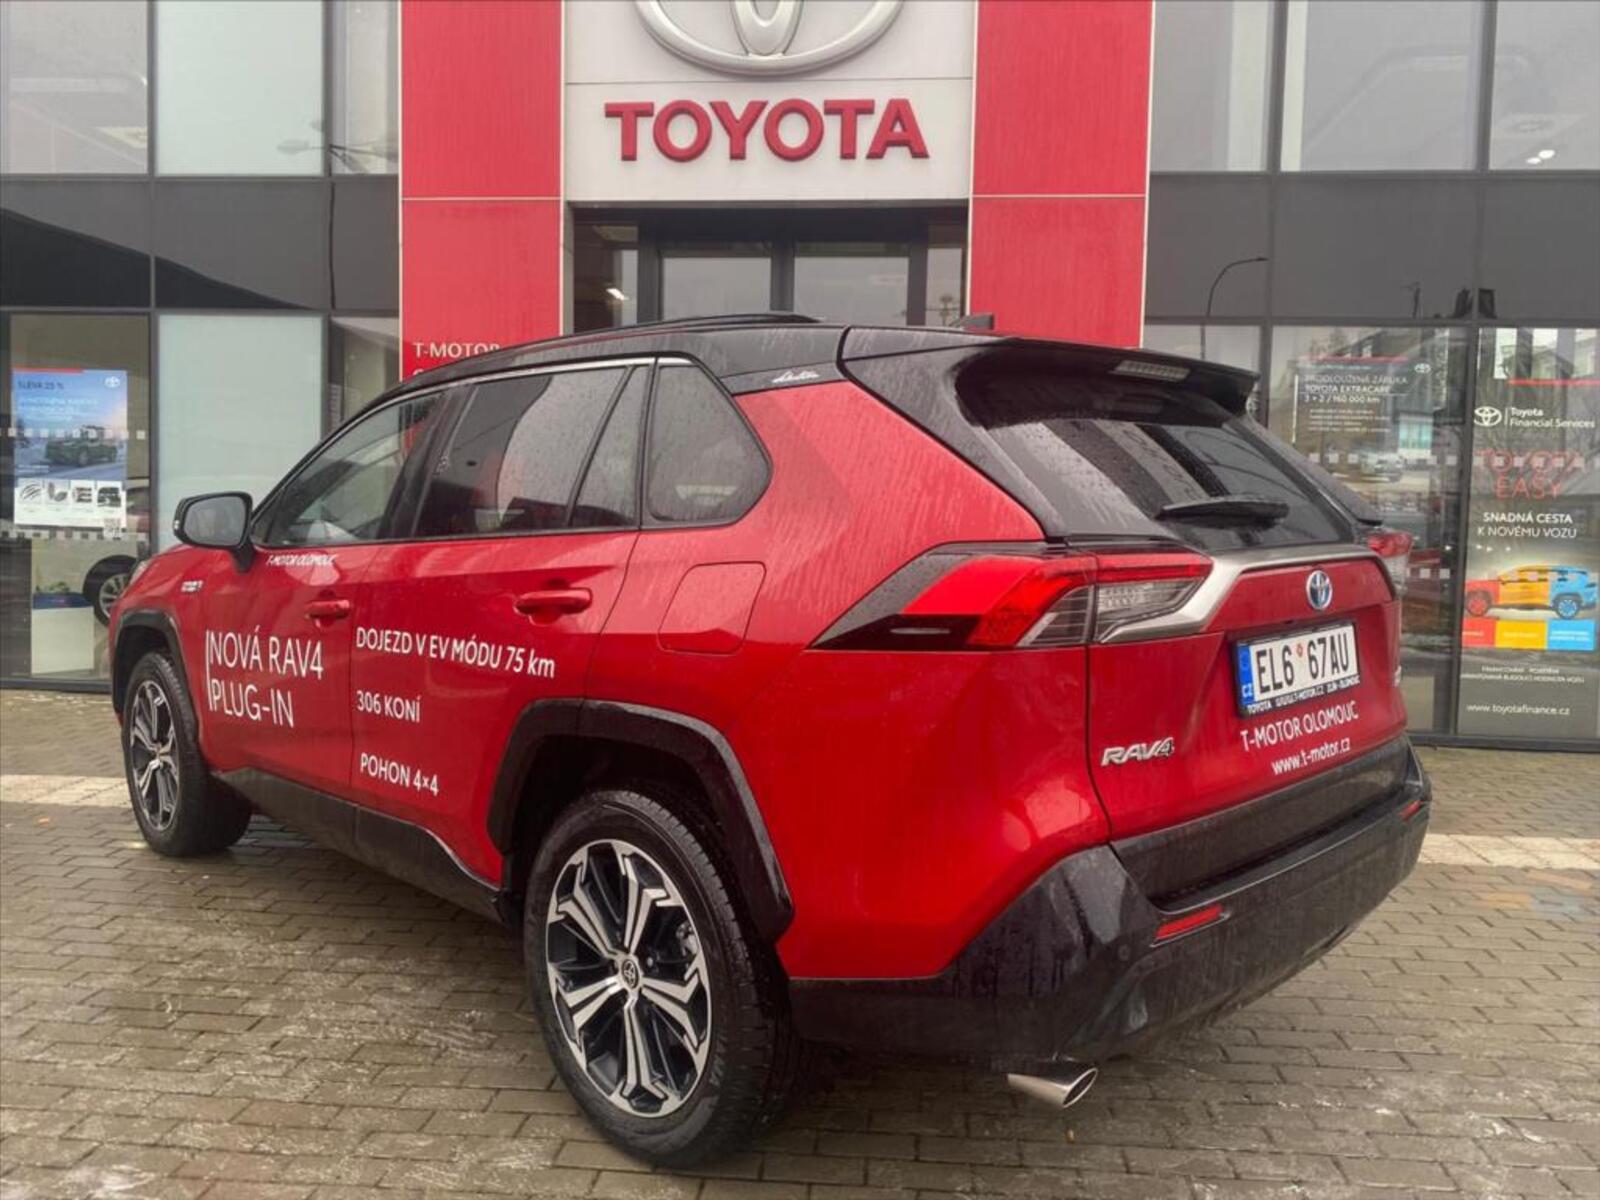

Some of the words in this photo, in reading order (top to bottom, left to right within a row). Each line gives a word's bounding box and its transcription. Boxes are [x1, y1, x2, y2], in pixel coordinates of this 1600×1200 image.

[604, 98, 930, 163] TOYOTA
[1510, 418, 1553, 427] Financial
[1555, 418, 1596, 429] Services
[1511, 407, 1544, 418] Toyota
[1473, 449, 1586, 473] TOYOTA
[1495, 473, 1565, 499] EASY
[1478, 526, 1486, 536] K
[1488, 524, 1541, 538] NOVÉMU
[1543, 527, 1577, 538] VOZU
[1483, 510, 1534, 523] SNADNÁ
[1536, 513, 1574, 524] CESTA
[210, 624, 263, 673] NOVÁ
[268, 635, 324, 680] RAV4
[356, 627, 412, 655] DOJEZD
[415, 633, 426, 656] V
[429, 635, 450, 660] EV
[451, 634, 503, 669] MÓDU
[505, 646, 525, 673] 75
[527, 648, 555, 679] km
[1255, 644, 1295, 695] EL6
[1306, 632, 1350, 680] 67AU
[211, 678, 294, 728] PLUG-IN
[356, 690, 381, 714] 306
[384, 695, 421, 723] KONÍ
[1242, 683, 1253, 699] CZ
[1466, 704, 1570, 716] www.toyotafinance.cz
[1240, 716, 1303, 752] T-MOTOR
[1303, 700, 1359, 734] OLOMOUC
[1101, 737, 1175, 767] RAV4
[1272, 737, 1350, 775] www.t-motor.cz
[360, 752, 411, 788] POHON
